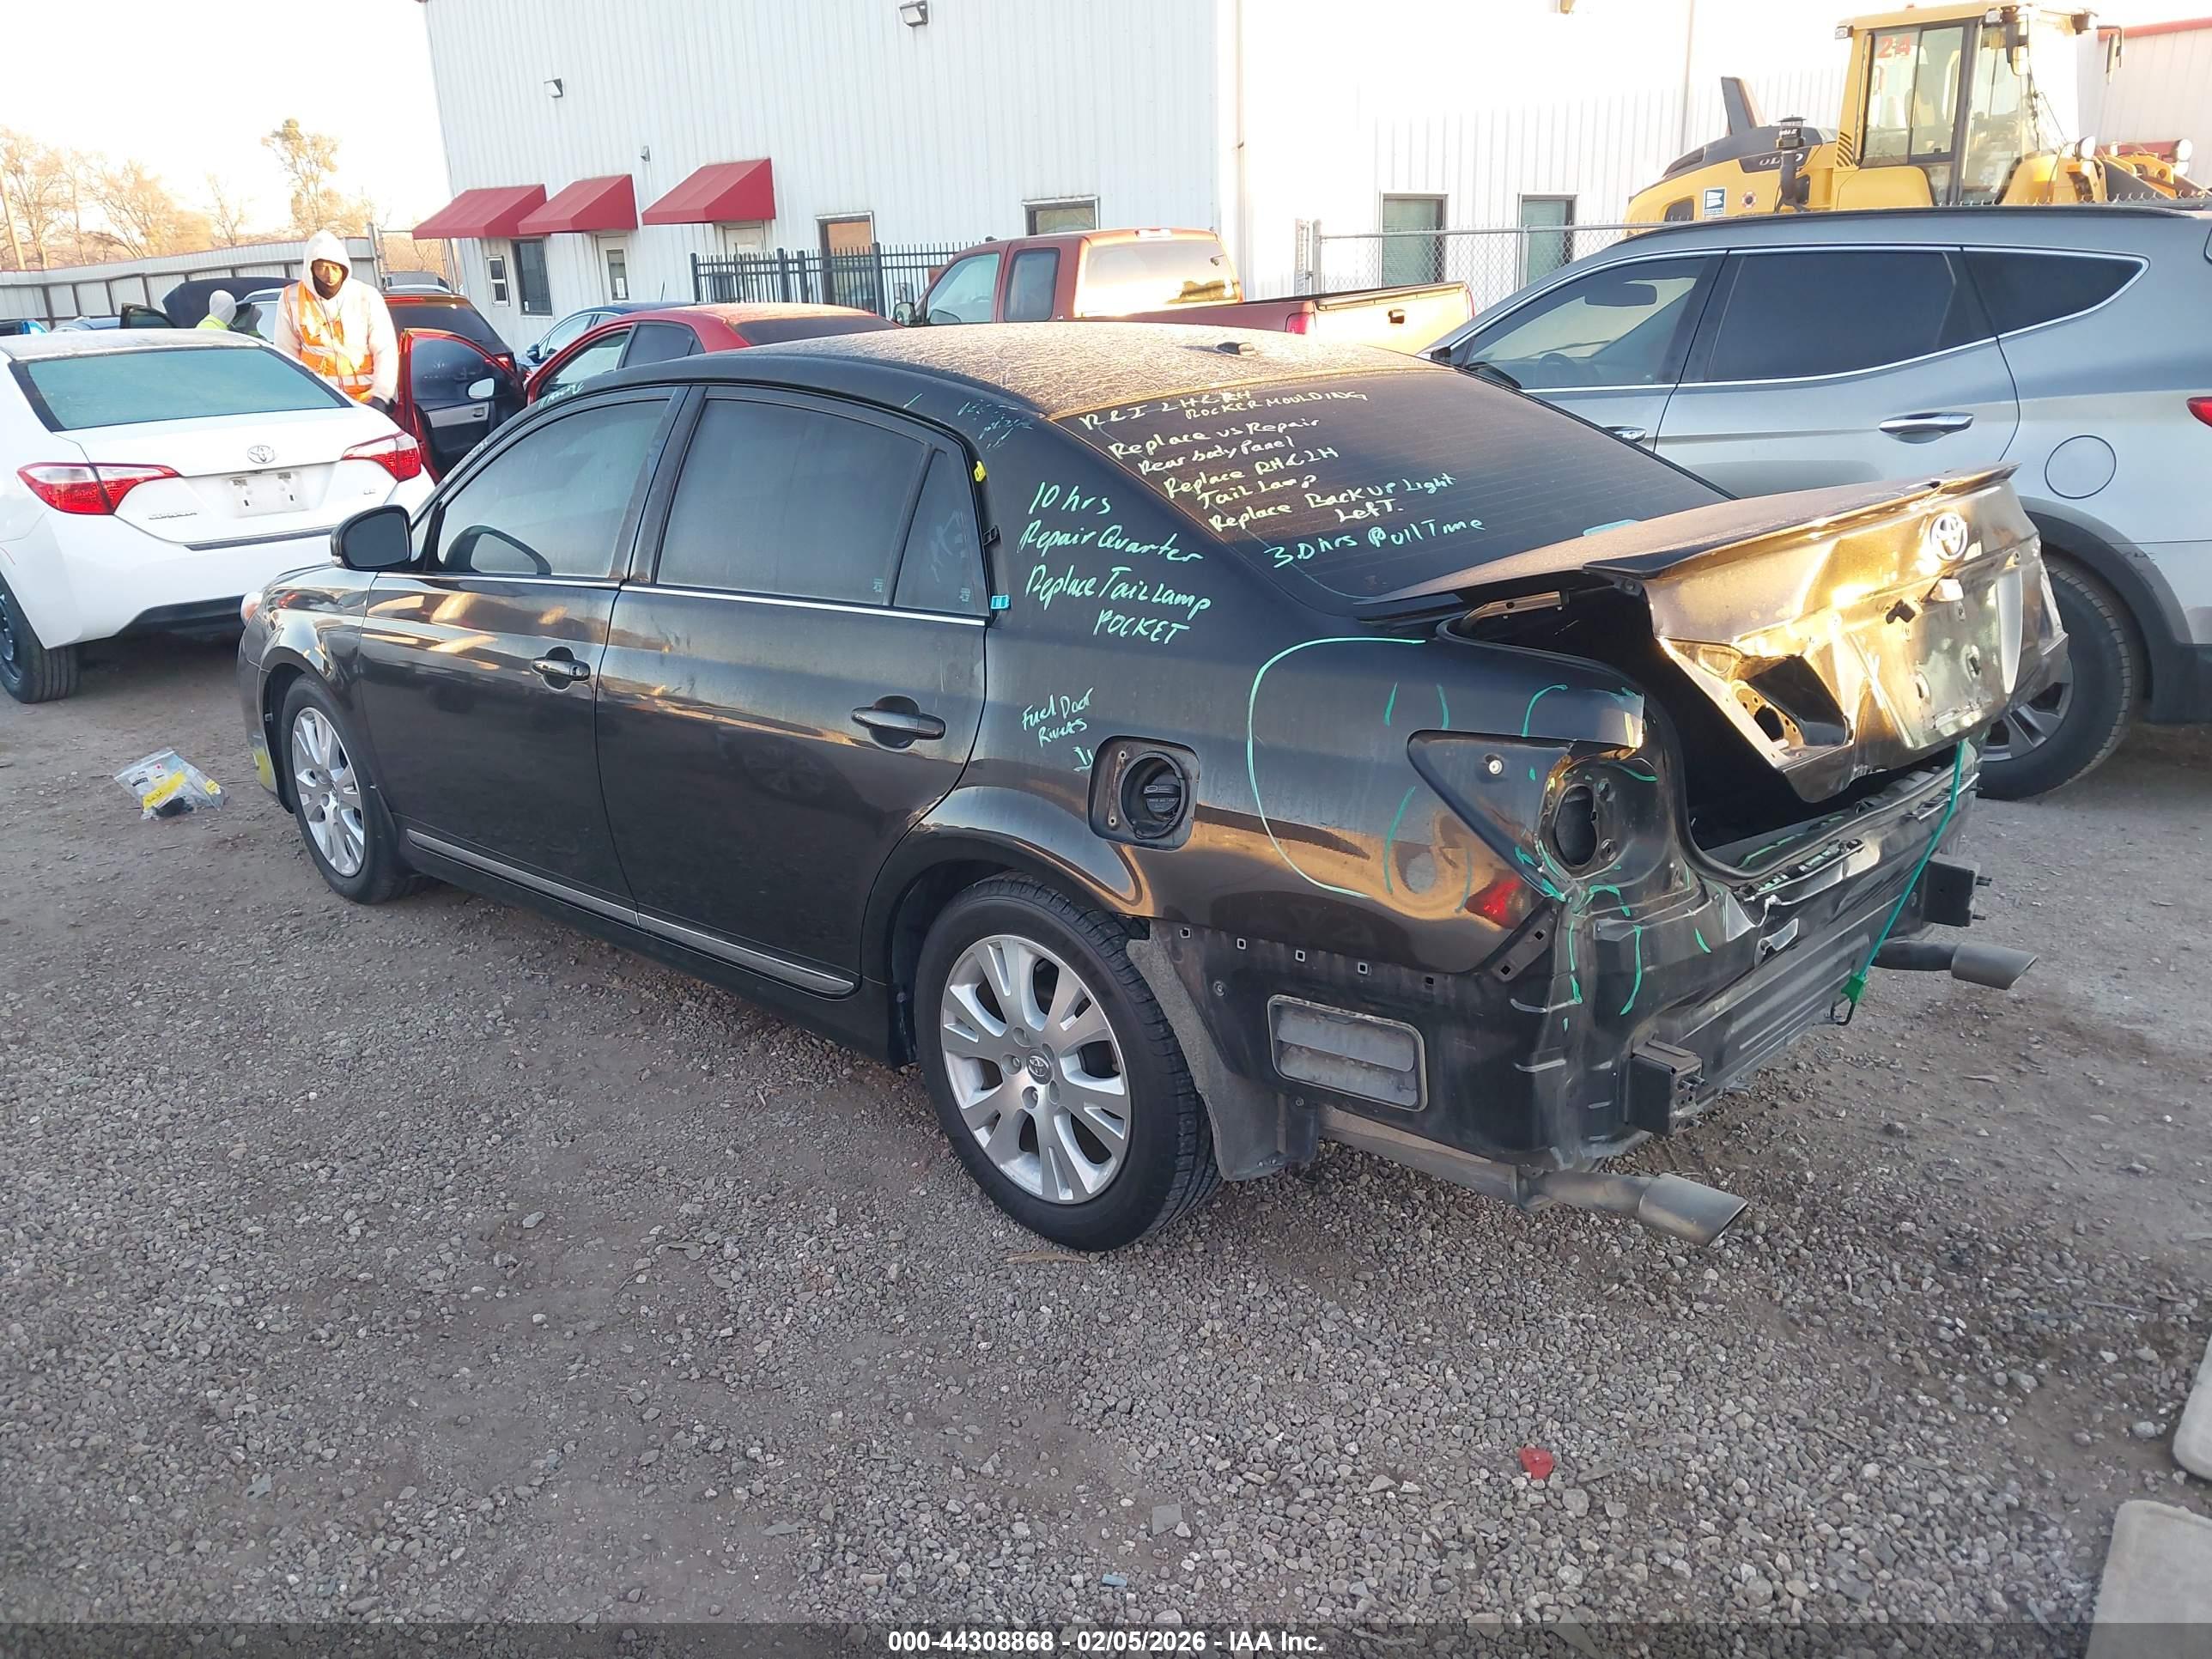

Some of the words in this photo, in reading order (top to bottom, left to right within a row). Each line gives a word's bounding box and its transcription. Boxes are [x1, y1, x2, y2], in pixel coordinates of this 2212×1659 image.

[1108, 434, 1212, 460] Replace
[1245, 418, 1320, 435] Repair
[1028, 481, 1060, 515] 10
[1060, 485, 1111, 515] hrs
[1163, 471, 1245, 500] Replace
[1208, 504, 1293, 532] Replace
[1016, 519, 1097, 557] Repair
[1025, 564, 1097, 611] Replace
[1151, 582, 1212, 621] Lamp
[1092, 608, 1191, 645] POCKET
[1022, 693, 1057, 731] Fuel
[1059, 687, 1094, 720] Door
